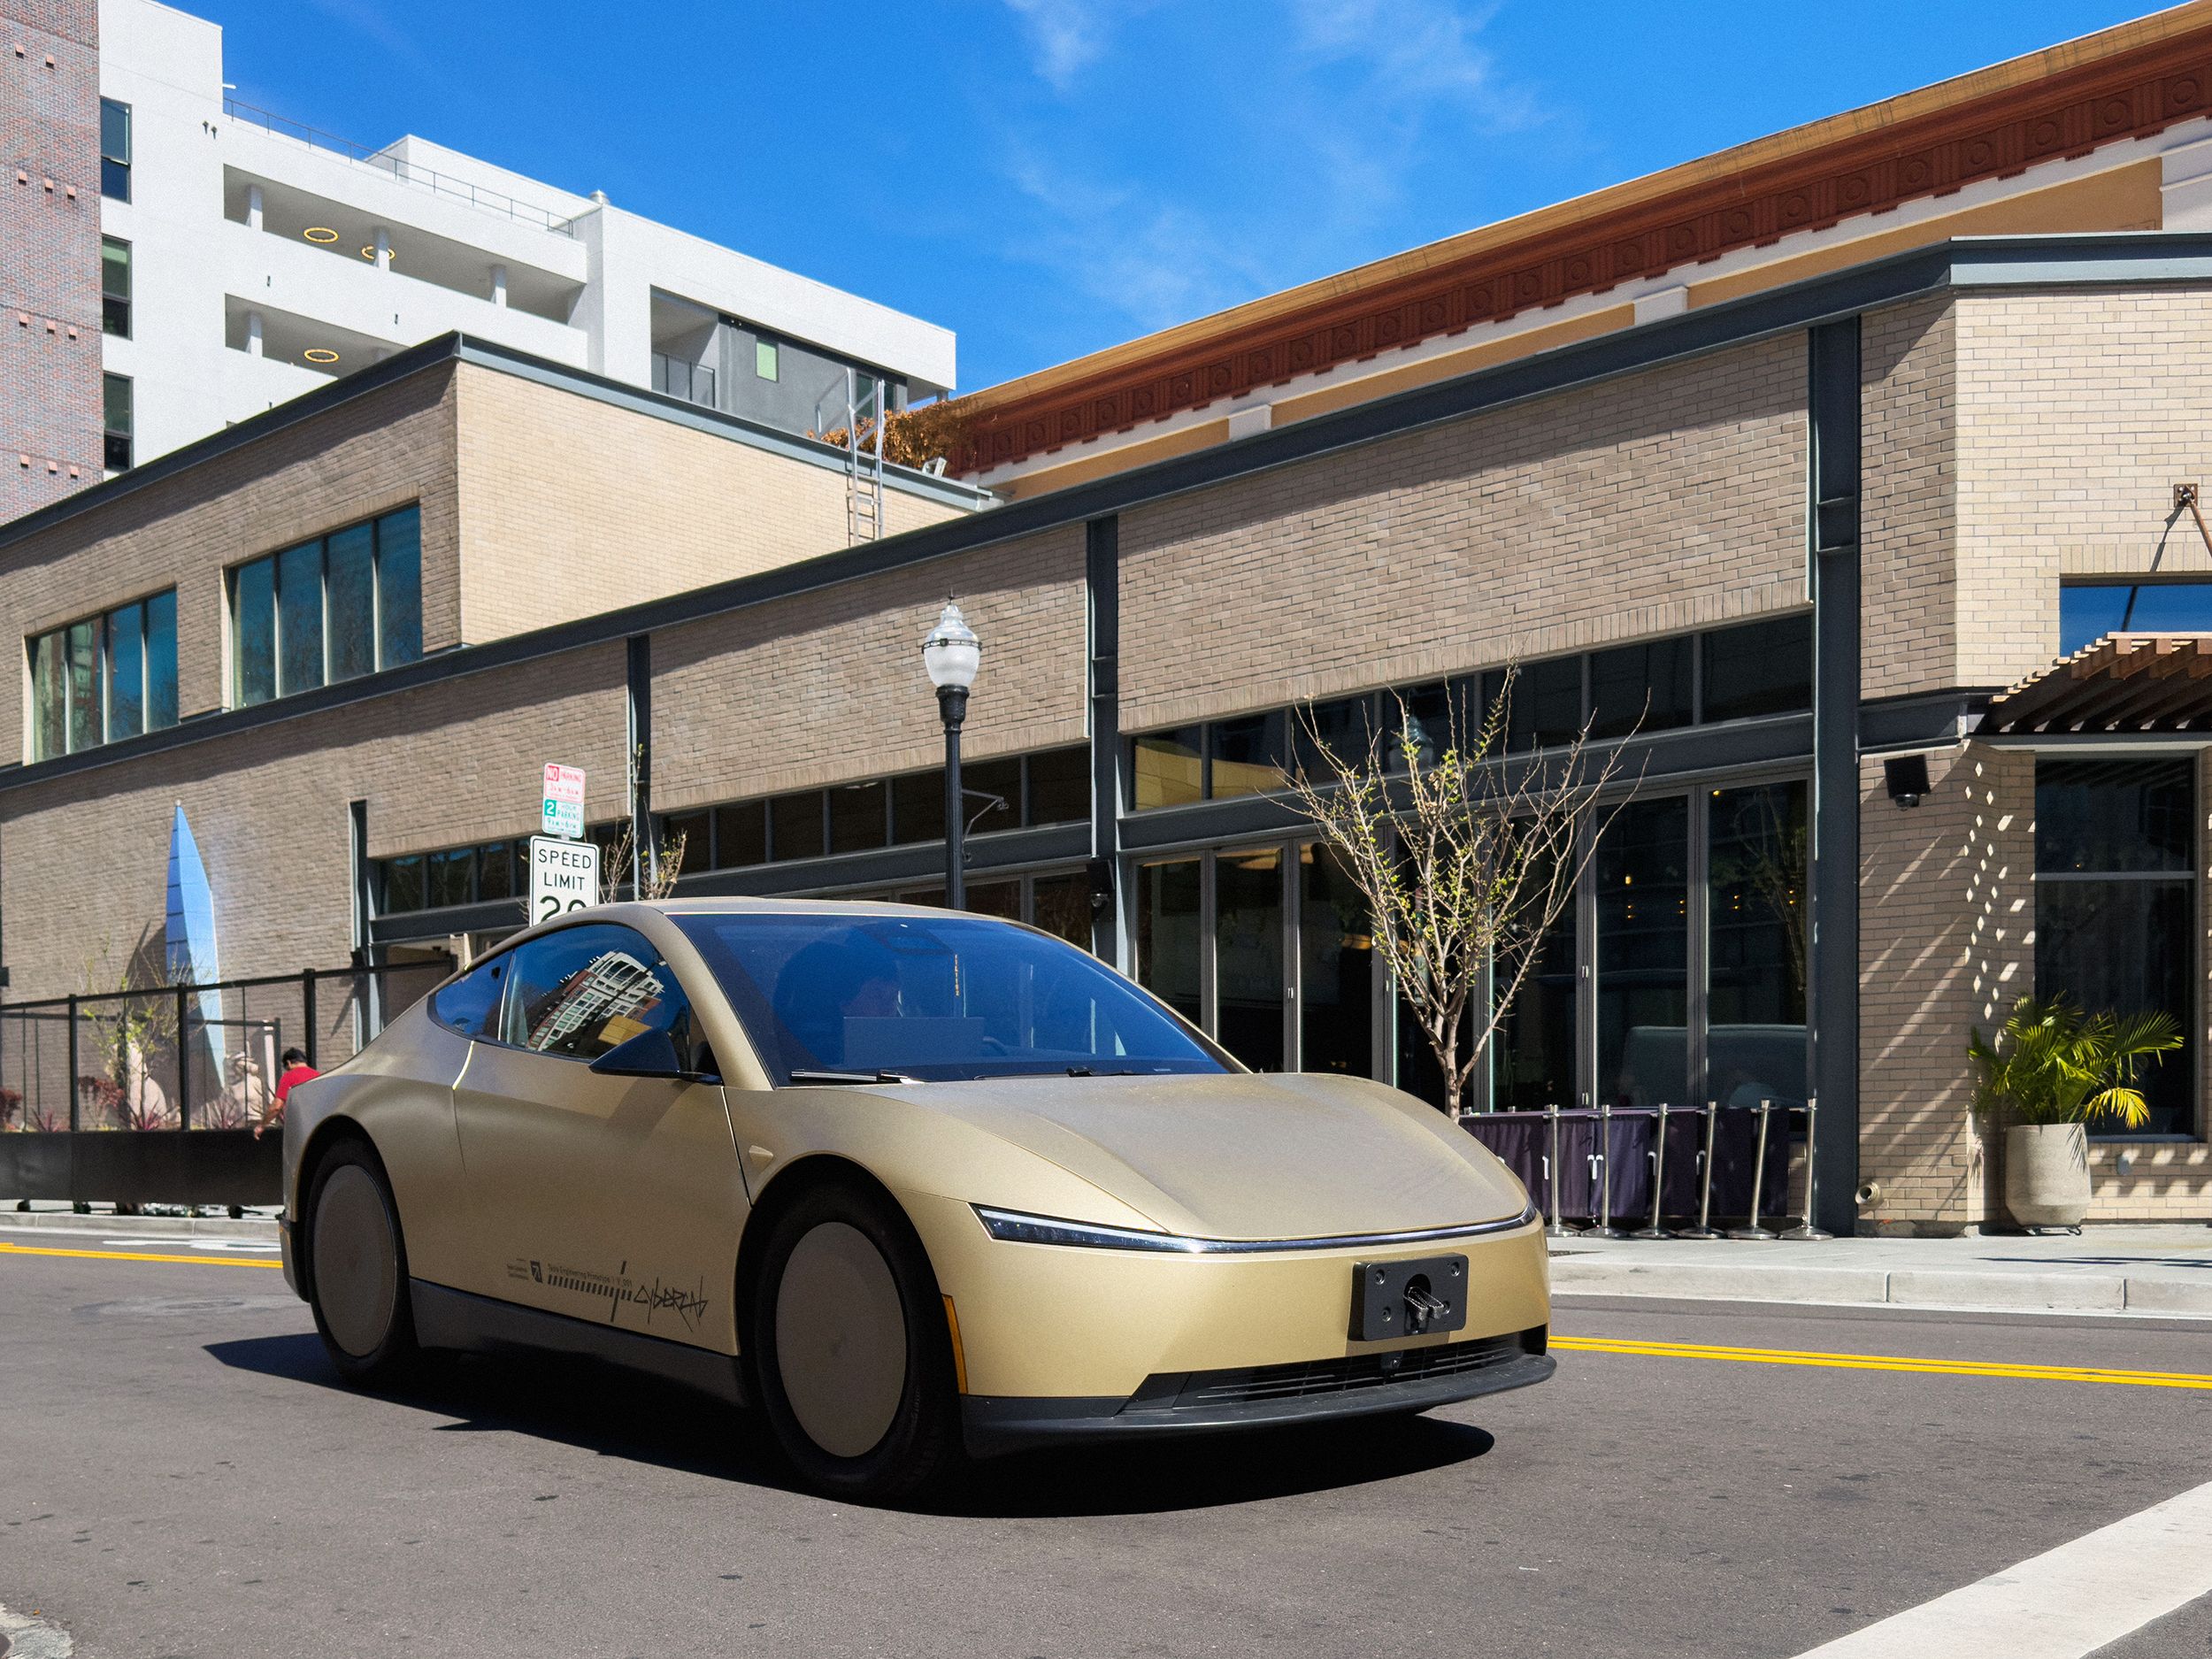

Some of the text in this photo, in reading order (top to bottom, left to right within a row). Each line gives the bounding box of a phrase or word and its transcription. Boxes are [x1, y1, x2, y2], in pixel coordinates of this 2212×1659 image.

[547, 767, 582, 783] NO PARKING
[546, 802, 555, 815] 2
[557, 810, 580, 821] PARKING
[538, 849, 592, 869] SPEED
[543, 872, 585, 891] LIMIT
